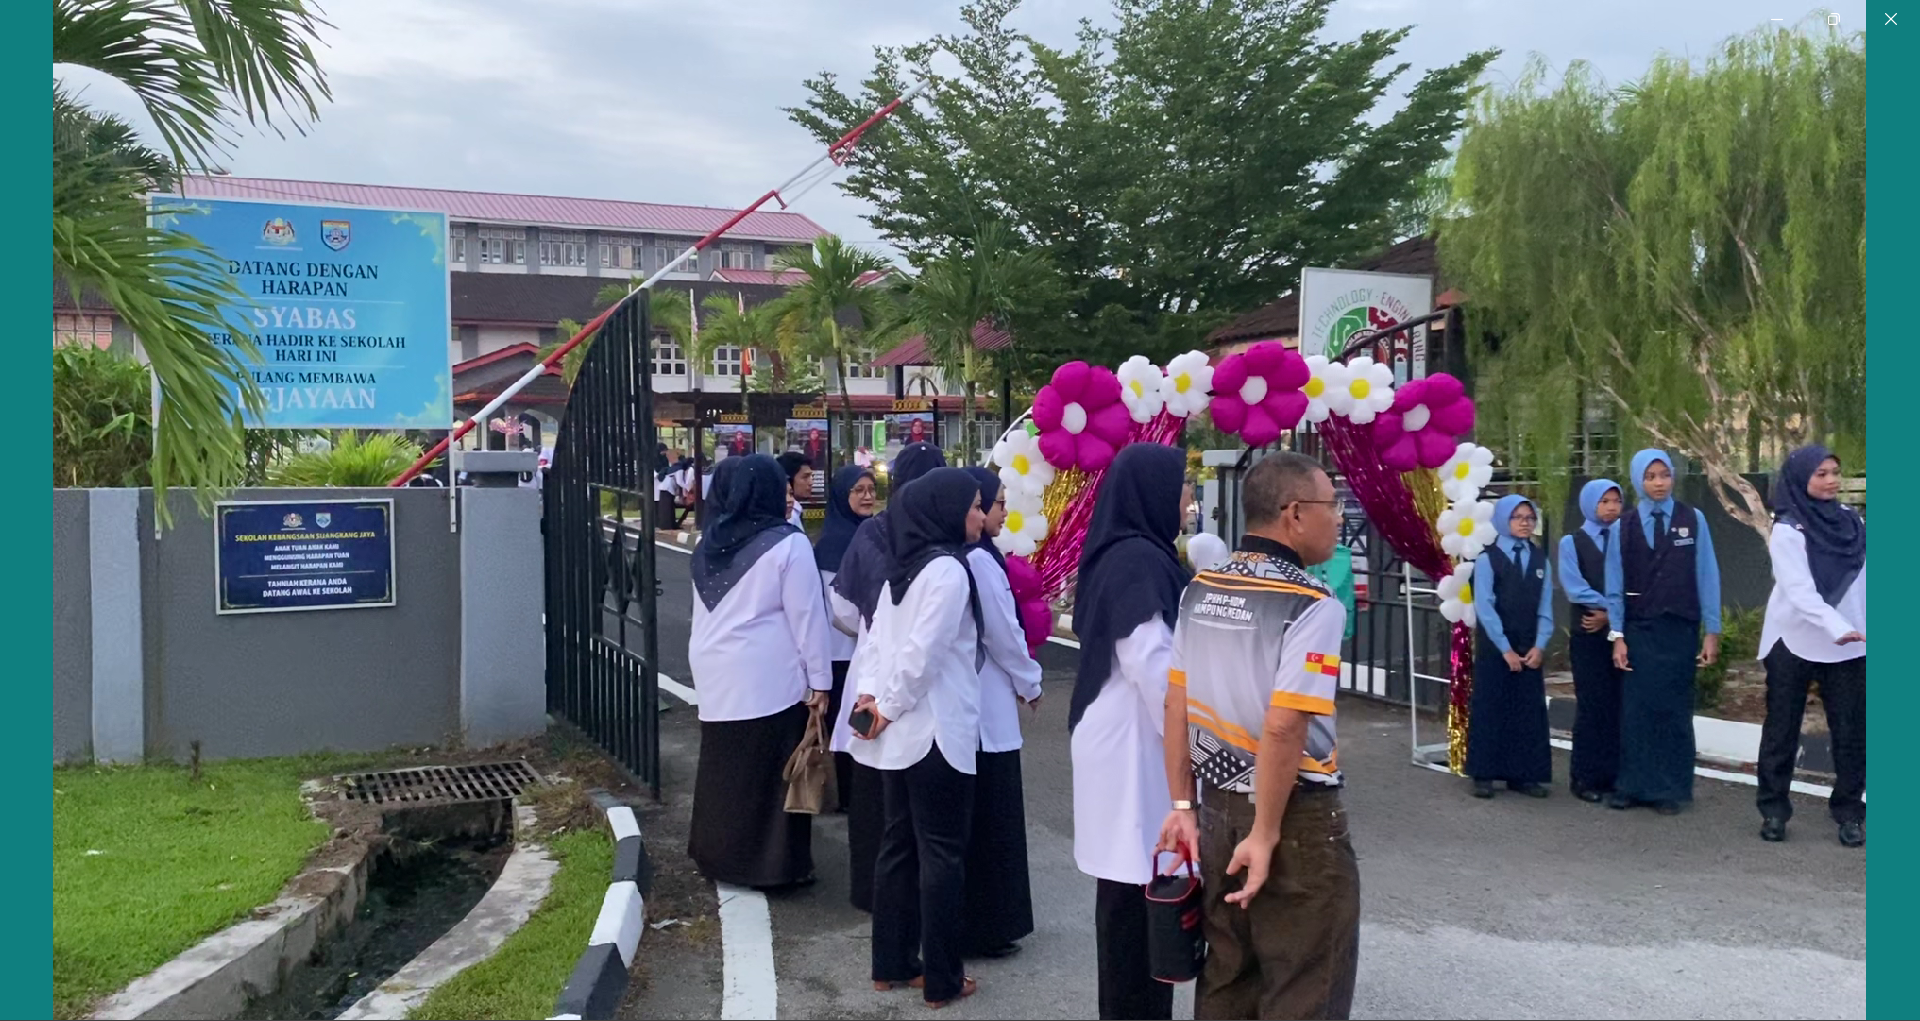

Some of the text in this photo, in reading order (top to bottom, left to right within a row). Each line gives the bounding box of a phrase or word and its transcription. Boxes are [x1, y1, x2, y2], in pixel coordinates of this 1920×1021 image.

[229, 260, 379, 280] DATANG DENGAN
[261, 279, 349, 297] HARAPAN
[253, 307, 357, 330] SYABAS
[1311, 288, 1374, 339] TECHNOLOGY
[266, 335, 314, 348] HADIR
[317, 336, 337, 348] KE
[340, 336, 406, 349] SEKOLAH
[275, 349, 337, 362] HARI INI
[298, 372, 377, 385] MEMBAWA
[234, 533, 267, 542] SEKOLAH
[268, 532, 315, 541] KEBANGSAAN
[359, 531, 375, 539] JAYA
[274, 544, 291, 552] ANAK
[291, 544, 307, 552] TUAN
[324, 543, 340, 551] KAMI
[336, 551, 349, 559] TUAN
[267, 578, 347, 587] TAHNIAH KERANA ANDA
[263, 586, 352, 598] DATANG AWAL KE SEKOLAH
